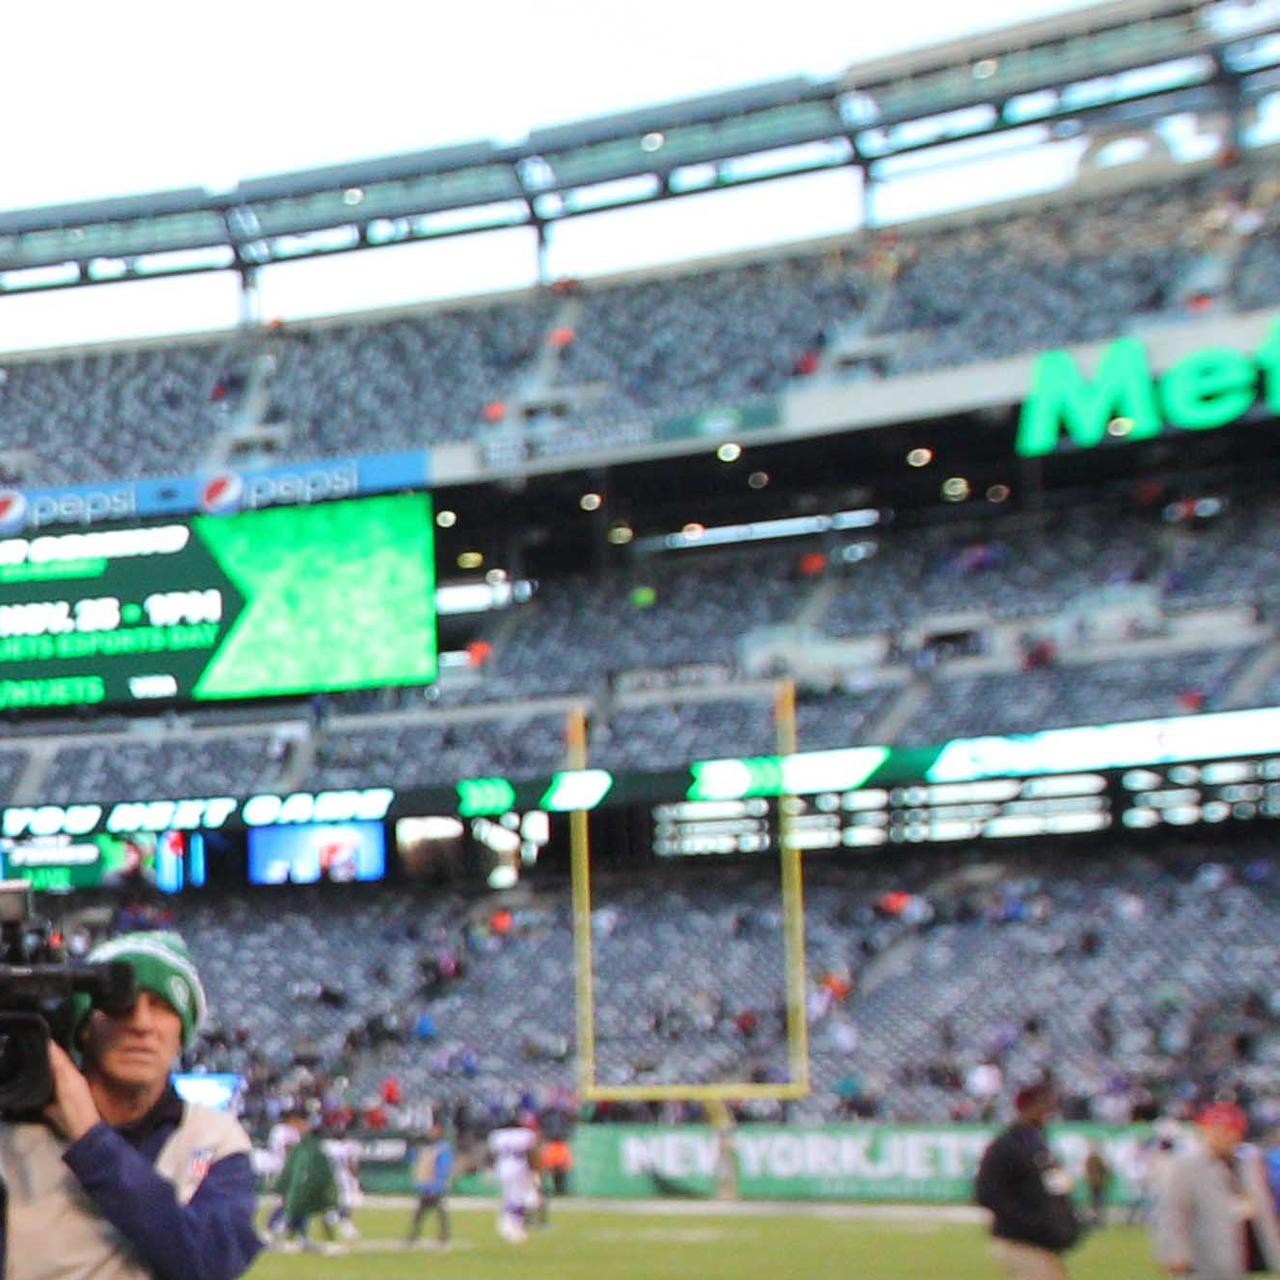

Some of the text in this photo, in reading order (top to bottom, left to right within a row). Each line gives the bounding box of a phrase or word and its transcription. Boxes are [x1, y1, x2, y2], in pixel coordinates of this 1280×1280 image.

[32, 487, 137, 527] pepsi
[250, 461, 359, 507] pepsi
[2, 804, 103, 836] YOU
[106, 798, 237, 832] NEXT
[243, 788, 395, 825] GAME
